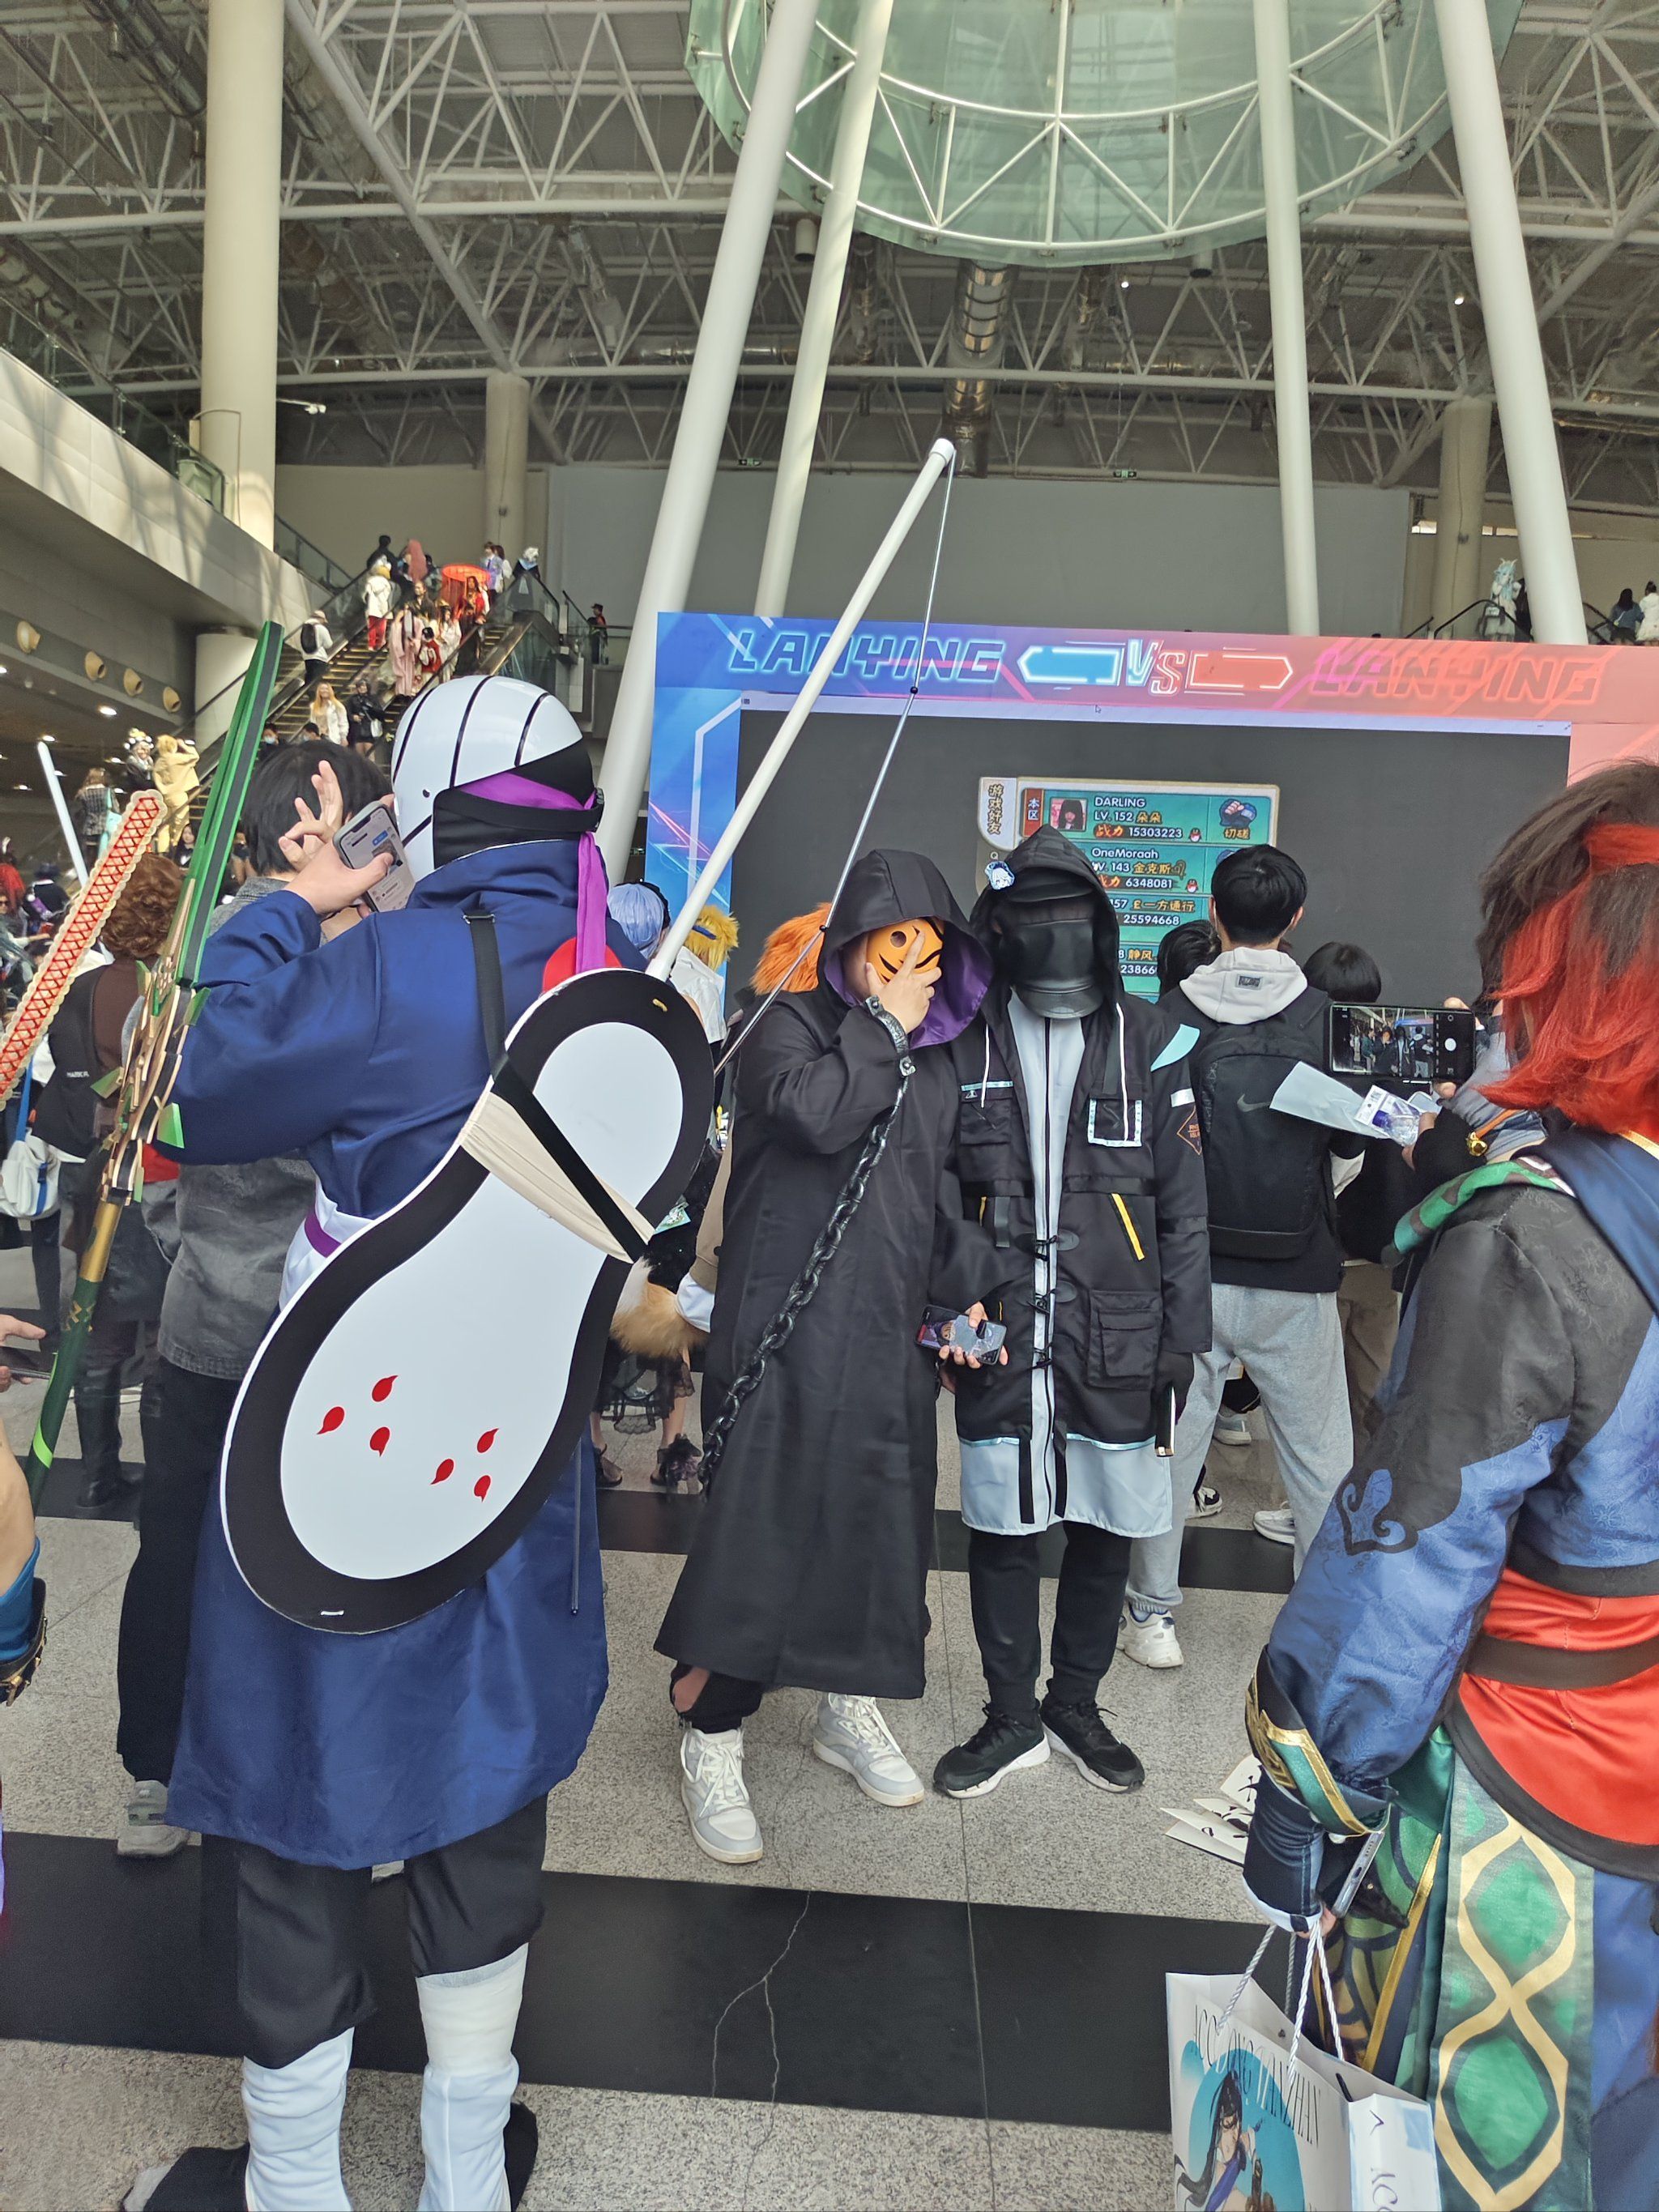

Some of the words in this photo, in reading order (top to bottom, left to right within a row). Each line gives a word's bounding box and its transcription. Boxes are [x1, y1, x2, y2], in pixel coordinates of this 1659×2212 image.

[1126, 638, 1188, 697] VS
[1094, 797, 1145, 808] DARLING
[987, 784, 1004, 835] 游戏好友
[1027, 798, 1040, 820] 本区
[1115, 812, 1133, 821] 152
[1095, 824, 1124, 837] 战力
[1128, 827, 1183, 837] 15303223
[1111, 862, 1130, 872] 143
[1126, 878, 1172, 889] 6348081
[1123, 914, 1180, 925] 25594668
